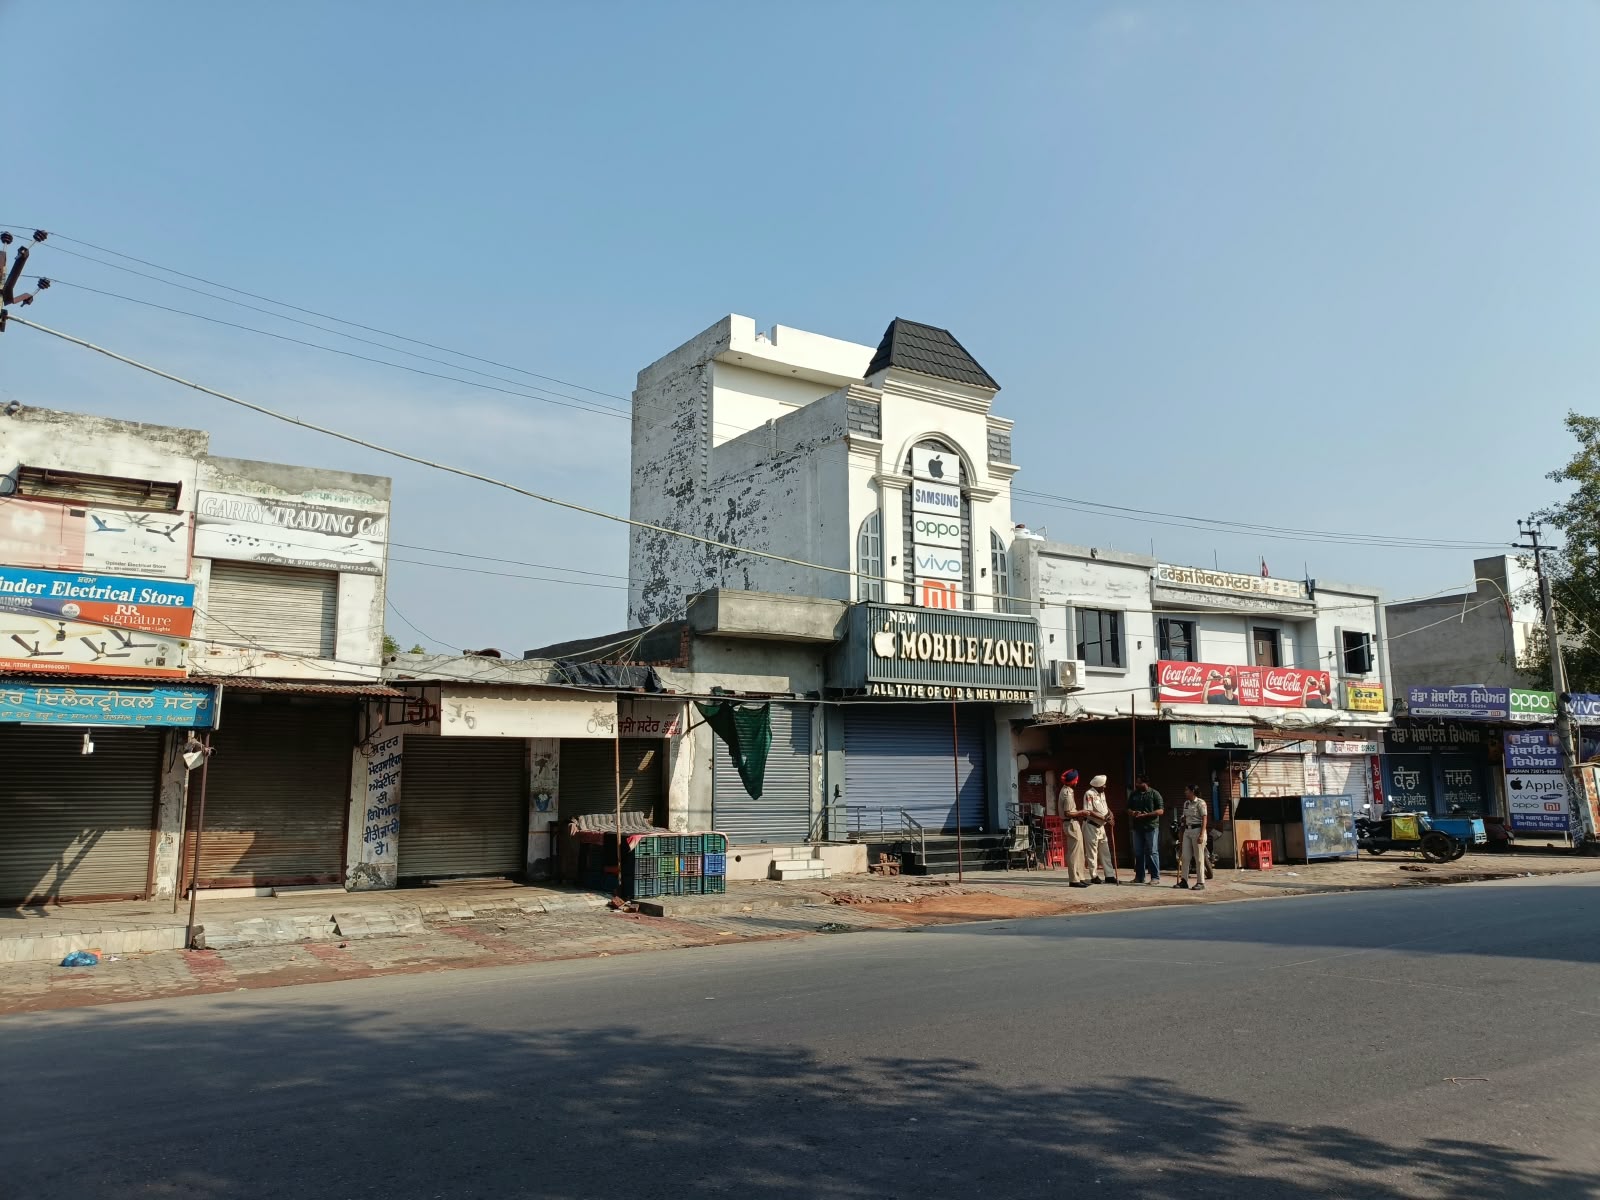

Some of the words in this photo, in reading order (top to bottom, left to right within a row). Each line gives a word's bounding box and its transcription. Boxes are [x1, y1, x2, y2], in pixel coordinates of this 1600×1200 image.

[915, 488, 959, 508] SAMSUNG
[201, 497, 269, 524] GARRY
[271, 506, 355, 534] TRADING
[357, 516, 384, 537] Co.
[915, 519, 960, 538] oppo
[916, 554, 961, 573] vivo
[50, 580, 137, 604] Electrical
[138, 588, 185, 606] Store
[115, 604, 140, 615] RR
[888, 610, 917, 625] NEW
[103, 612, 172, 626] signature
[900, 630, 979, 665] MOBILE
[981, 637, 1036, 668] ZONE
[1240, 678, 1260, 688] AHATA
[163, 692, 210, 710] ਸਟੋਰ
[873, 684, 894, 696] ALL
[896, 684, 924, 698] TYPE
[927, 686, 941, 697] OF
[966, 688, 973, 698] &
[976, 688, 998, 700] NEW
[999, 690, 1034, 701] MOBILE
[1242, 687, 1259, 698] WALE
[1510, 693, 1550, 712] oppo
[637, 715, 661, 732] ਸਟੋਰ
[1525, 780, 1564, 792] Apple
